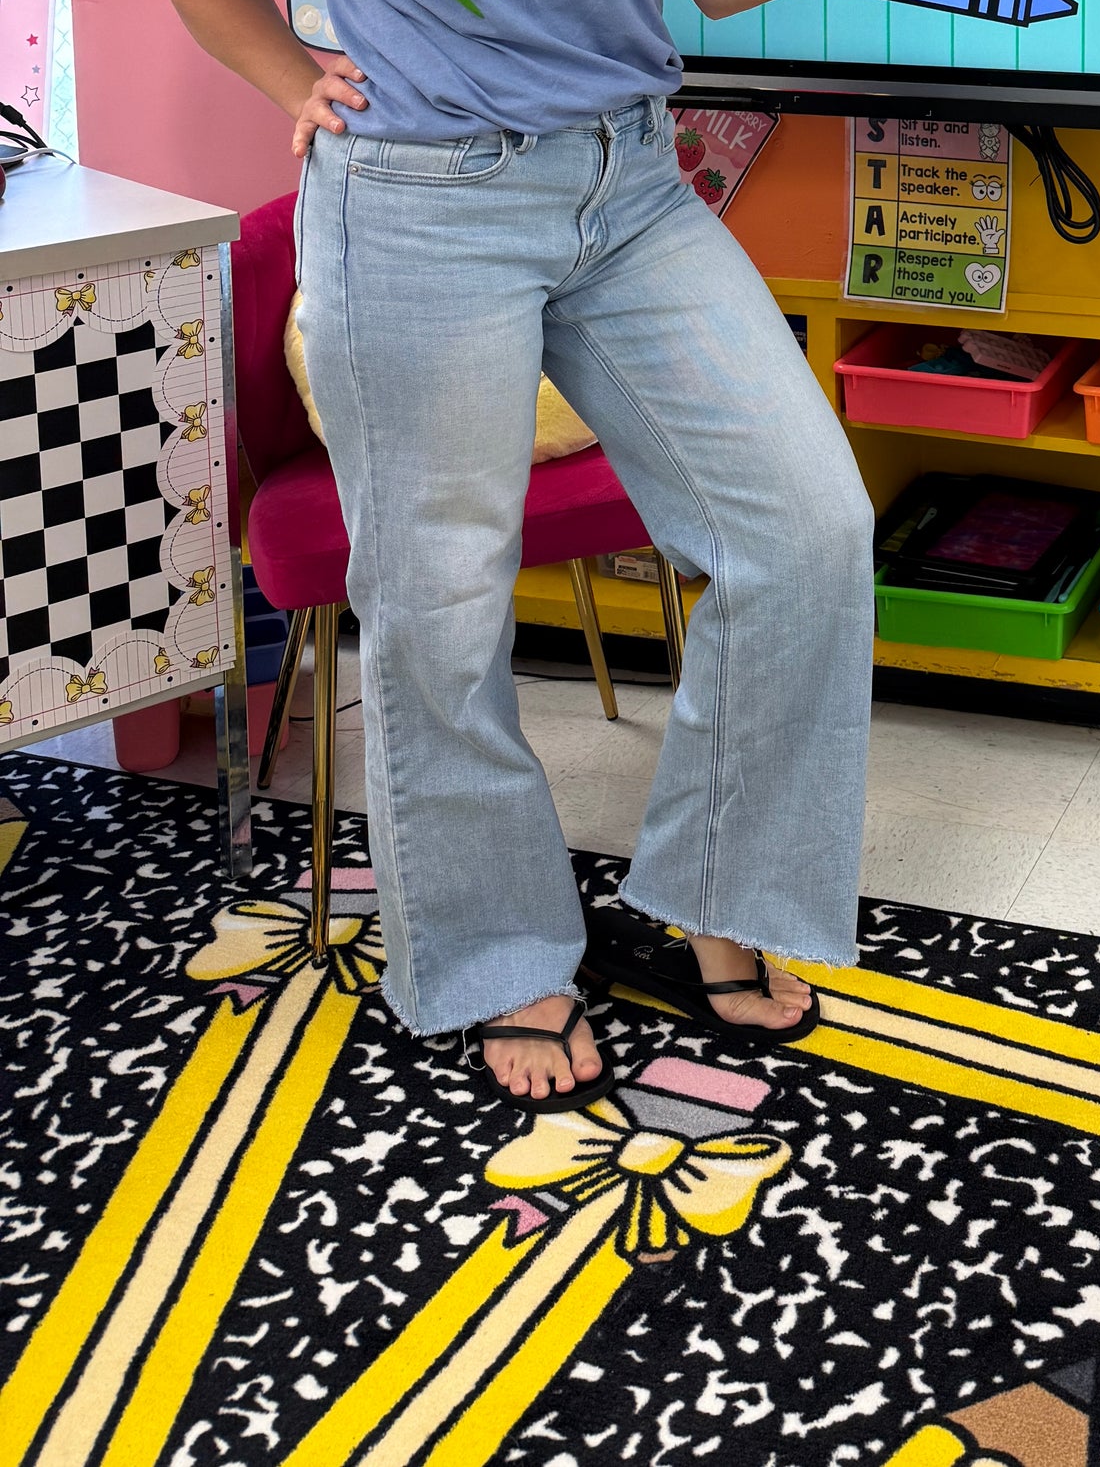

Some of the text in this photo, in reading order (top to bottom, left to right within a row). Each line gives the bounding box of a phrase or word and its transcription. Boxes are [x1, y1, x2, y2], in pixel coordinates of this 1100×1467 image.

[693, 109, 753, 150] MILK
[867, 118, 888, 142] S
[923, 121, 939, 134] up
[944, 123, 969, 134] and
[901, 134, 941, 148] listen.
[867, 159, 886, 189] T
[901, 164, 968, 181] Track the
[901, 182, 960, 196] speaker.
[865, 205, 886, 236] A
[900, 211, 957, 230] Actively
[899, 229, 980, 245] participate.
[862, 253, 883, 284] R
[898, 251, 954, 268] Respect
[897, 268, 934, 282] those
[895, 285, 976, 304] around you.
